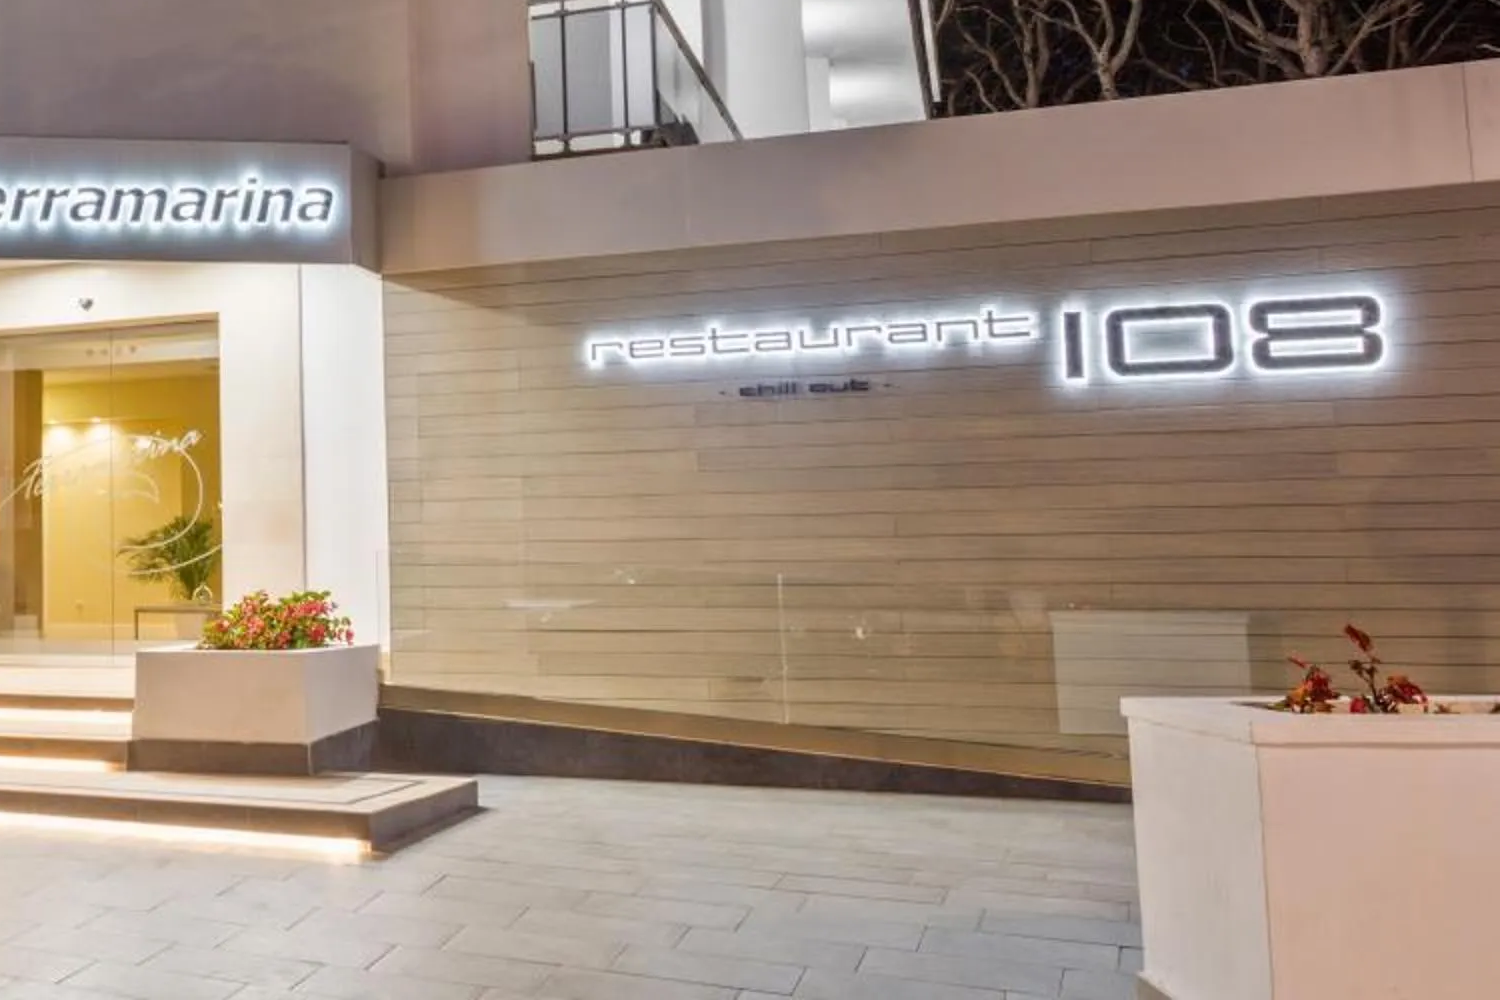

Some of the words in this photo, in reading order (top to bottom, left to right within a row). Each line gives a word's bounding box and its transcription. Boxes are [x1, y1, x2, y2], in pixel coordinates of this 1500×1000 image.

[590, 309, 1033, 363] restaurant
[1062, 294, 1385, 379] 108
[807, 378, 870, 394] out
